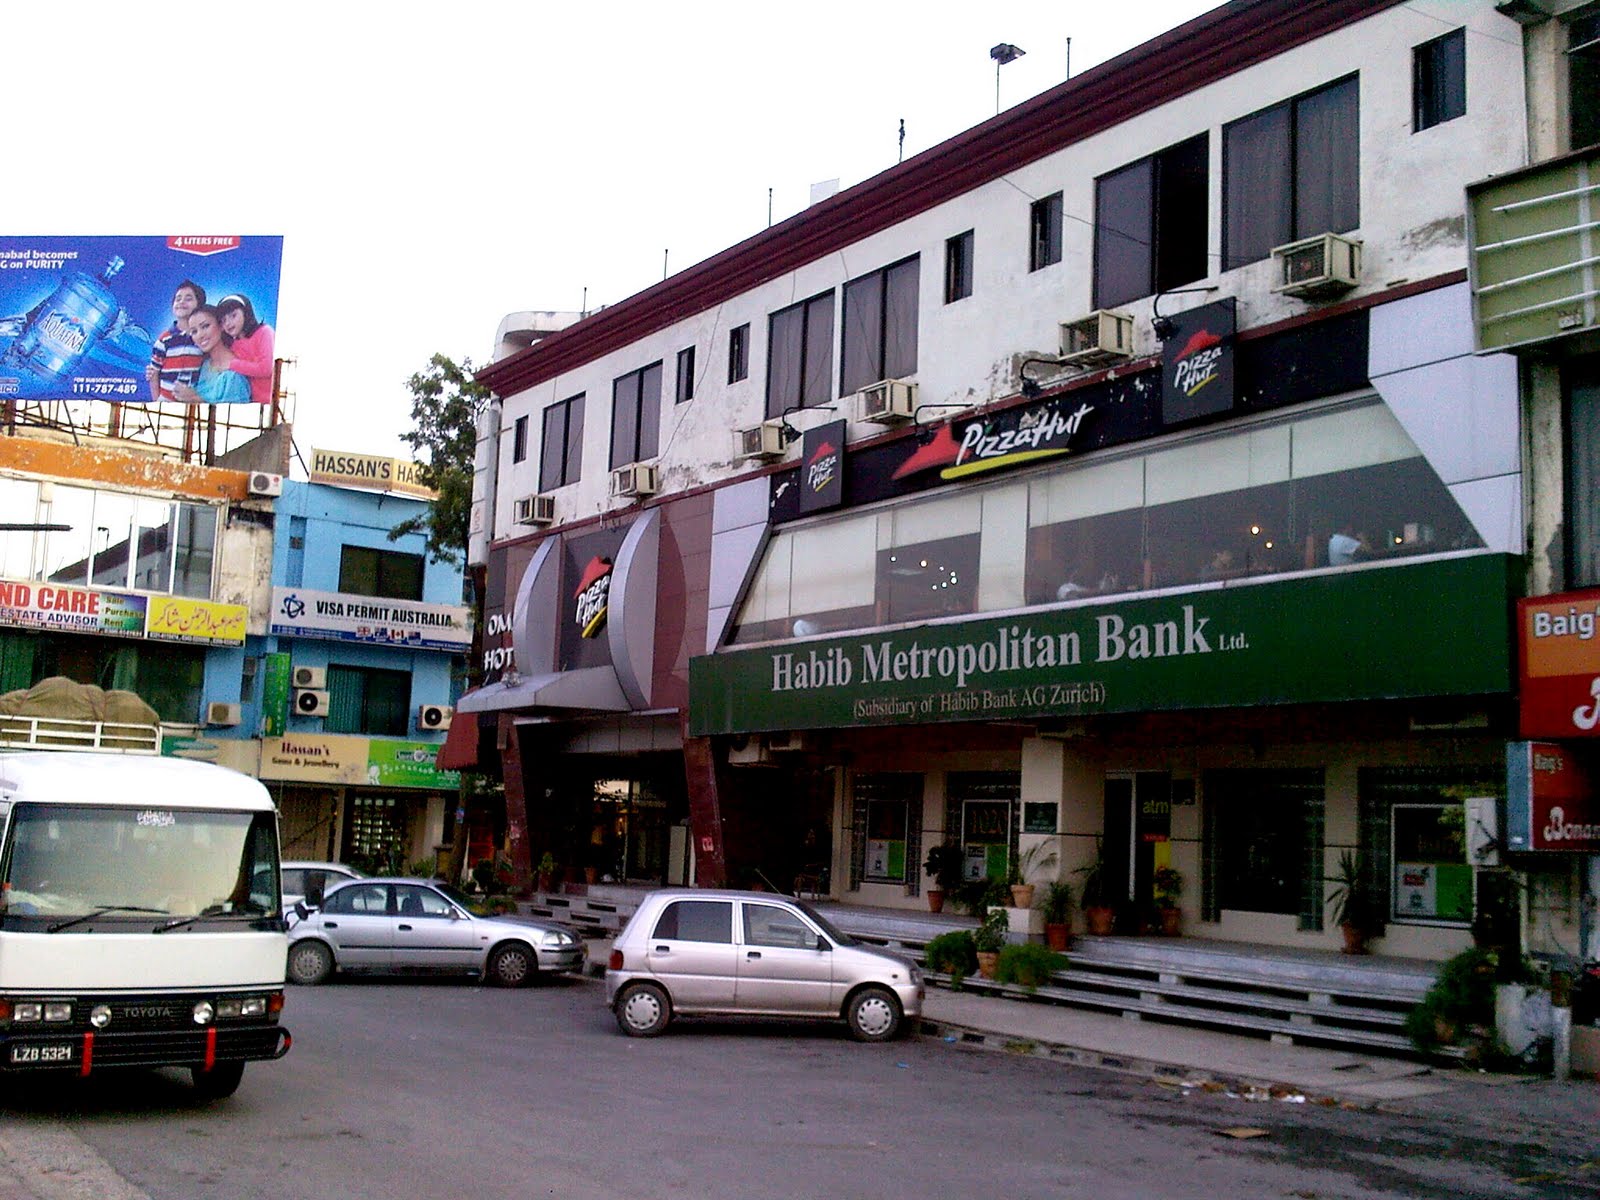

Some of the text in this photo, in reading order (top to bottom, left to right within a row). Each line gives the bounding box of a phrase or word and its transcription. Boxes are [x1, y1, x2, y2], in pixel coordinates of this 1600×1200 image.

[174, 236, 233, 247] 4 LITERS FREE
[33, 249, 78, 259] becomes
[10, 261, 23, 269] on
[26, 260, 65, 269] PURITY
[41, 310, 89, 352] AQUAFINA
[1174, 346, 1223, 393] Pizza Hut
[73, 383, 138, 394] 111-787-489
[315, 454, 391, 479] HASSAN'S
[808, 455, 837, 485] Pizza
[37, 586, 100, 615] CARE
[1, 607, 98, 626] ESTATE ADVISOR
[105, 607, 145, 619] Purchase
[316, 600, 344, 616] VISA
[347, 604, 390, 620] PERMIT
[391, 608, 453, 627] AUSTRALIA
[104, 617, 124, 627] Rent
[771, 604, 1250, 691] Habib Metropolitan Bank Ltd.
[853, 682, 1106, 719] (Subsidiary of Habib Bank AG Zurich)
[1142, 799, 1170, 815] atm
[123, 1006, 171, 1018] TOYOTA
[41, 1046, 72, 1061] 5321
